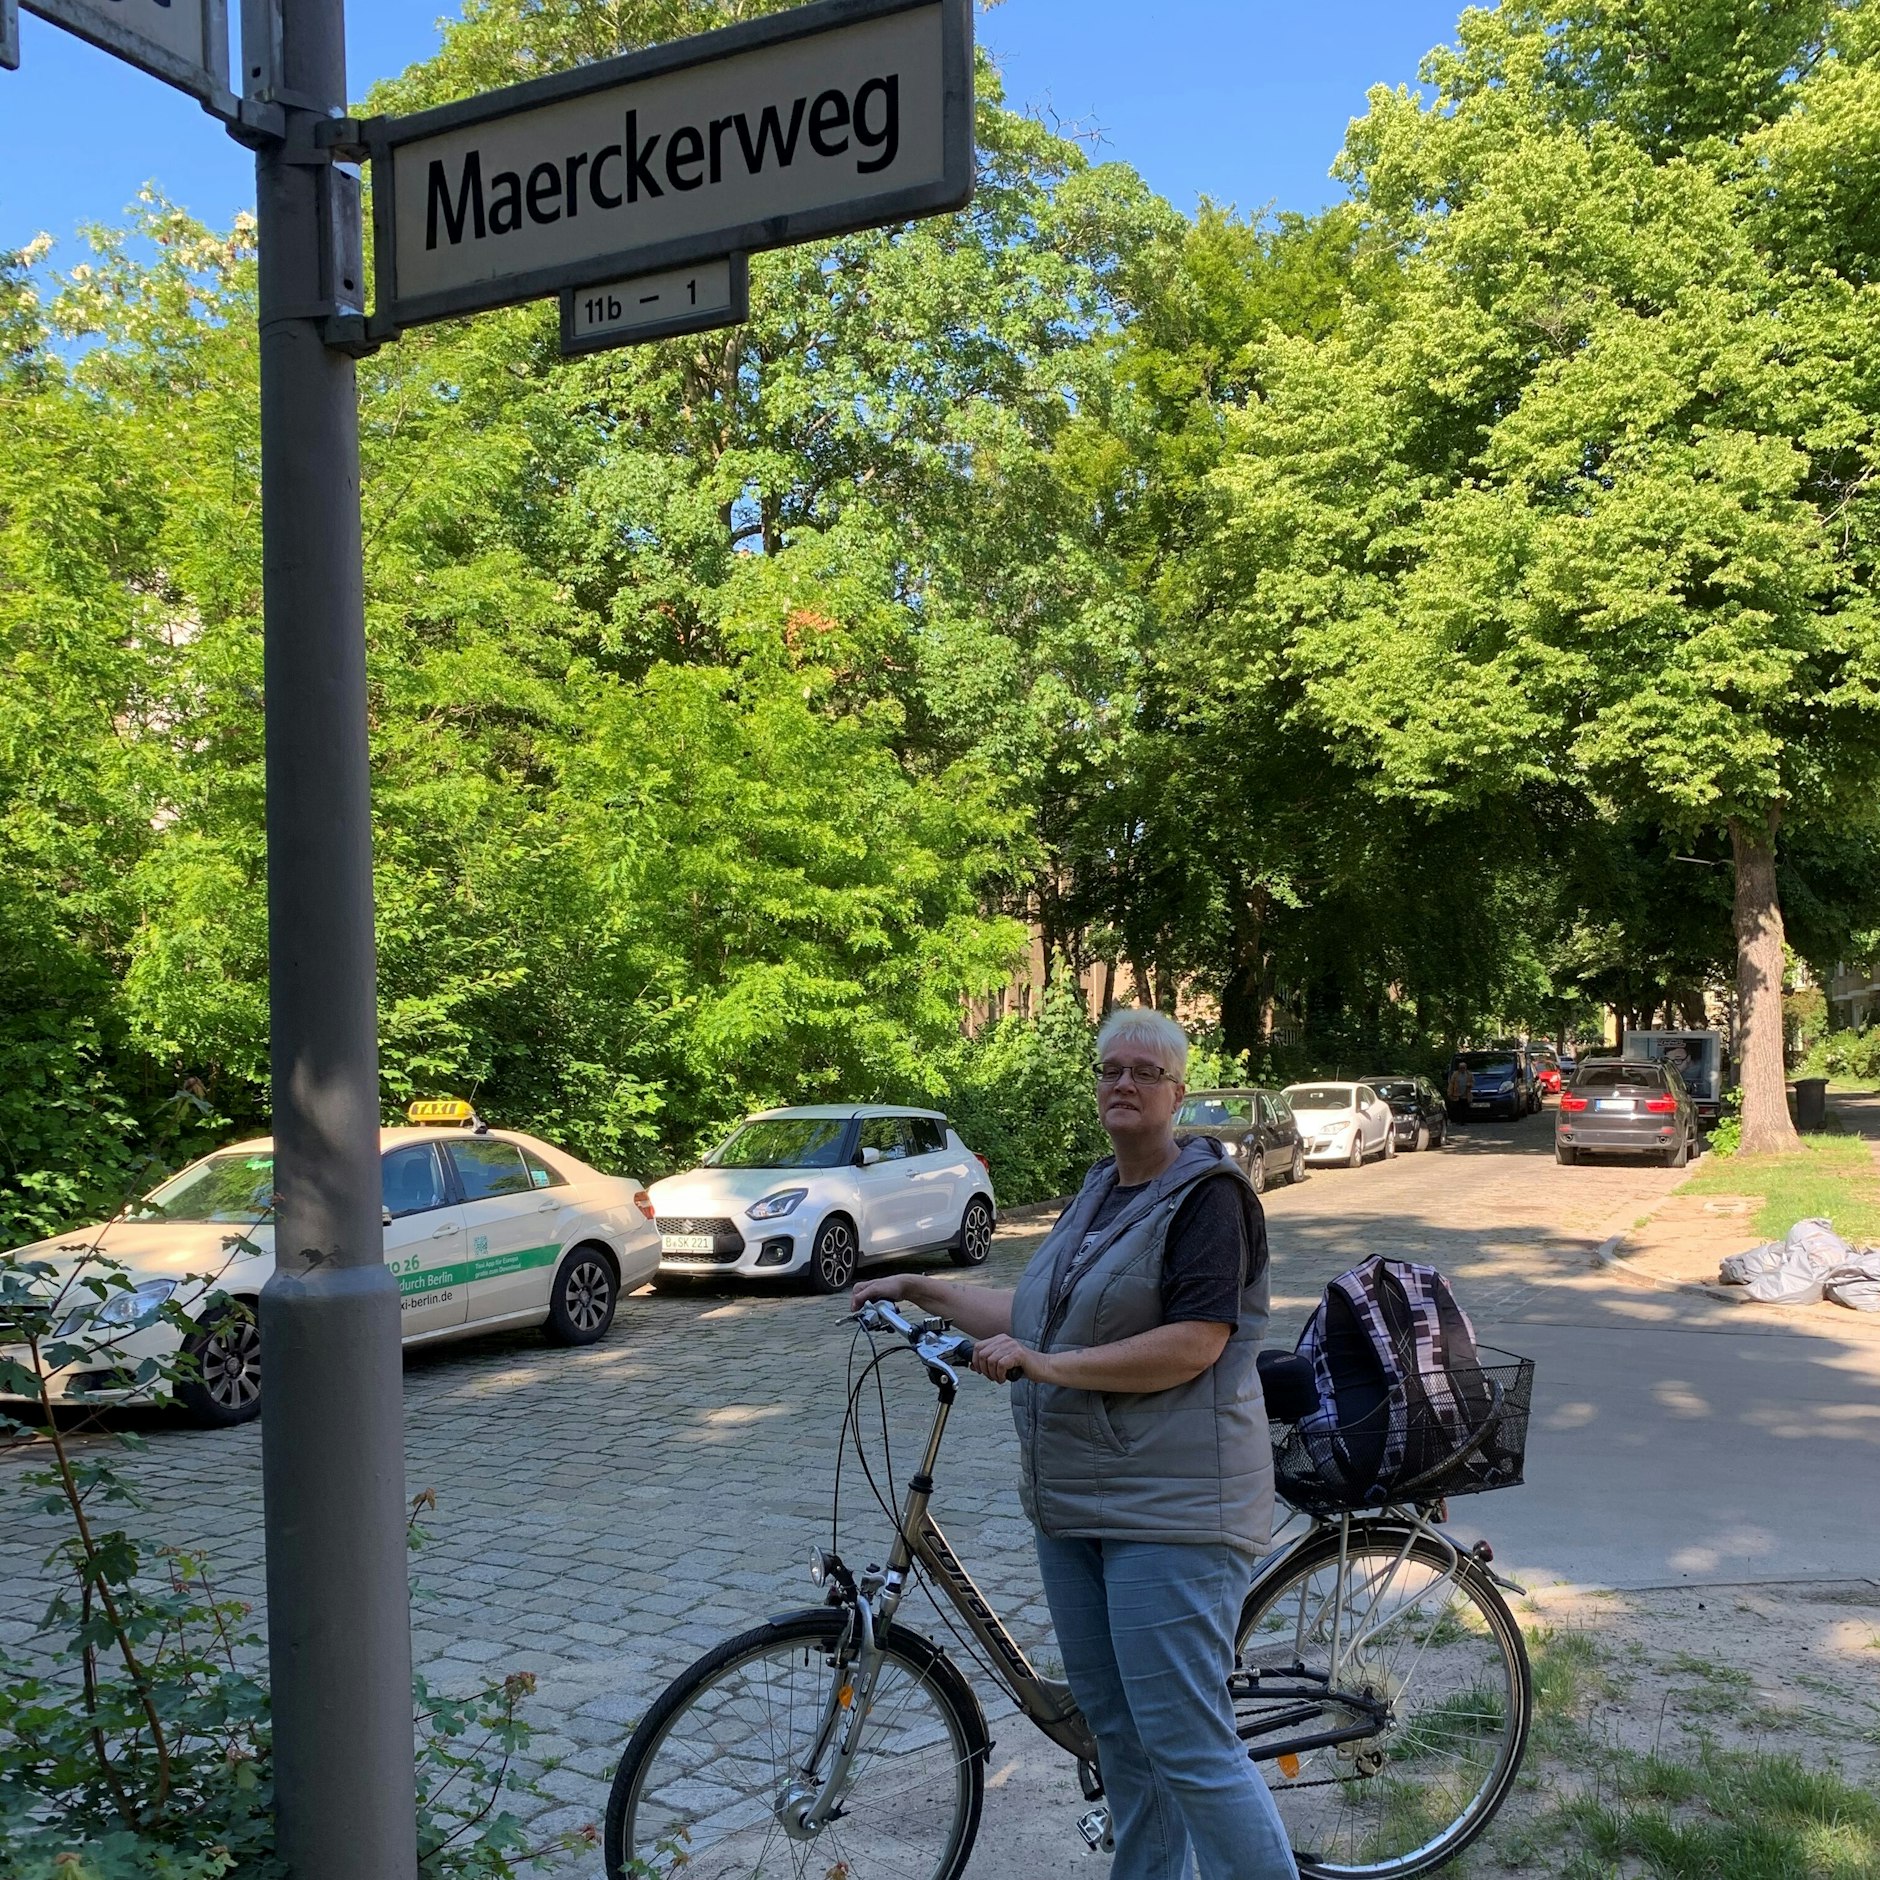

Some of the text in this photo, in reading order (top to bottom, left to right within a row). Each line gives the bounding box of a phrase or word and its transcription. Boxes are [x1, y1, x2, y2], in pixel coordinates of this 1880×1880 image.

[425, 73, 899, 251] Maerckerweg
[585, 295, 623, 325] 11b
[686, 279, 698, 306] 1
[416, 1103, 452, 1115] TAXI
[404, 1254, 420, 1272] 26
[400, 1271, 453, 1292] durch Berlin
[921, 1530, 1034, 1680] corratec
